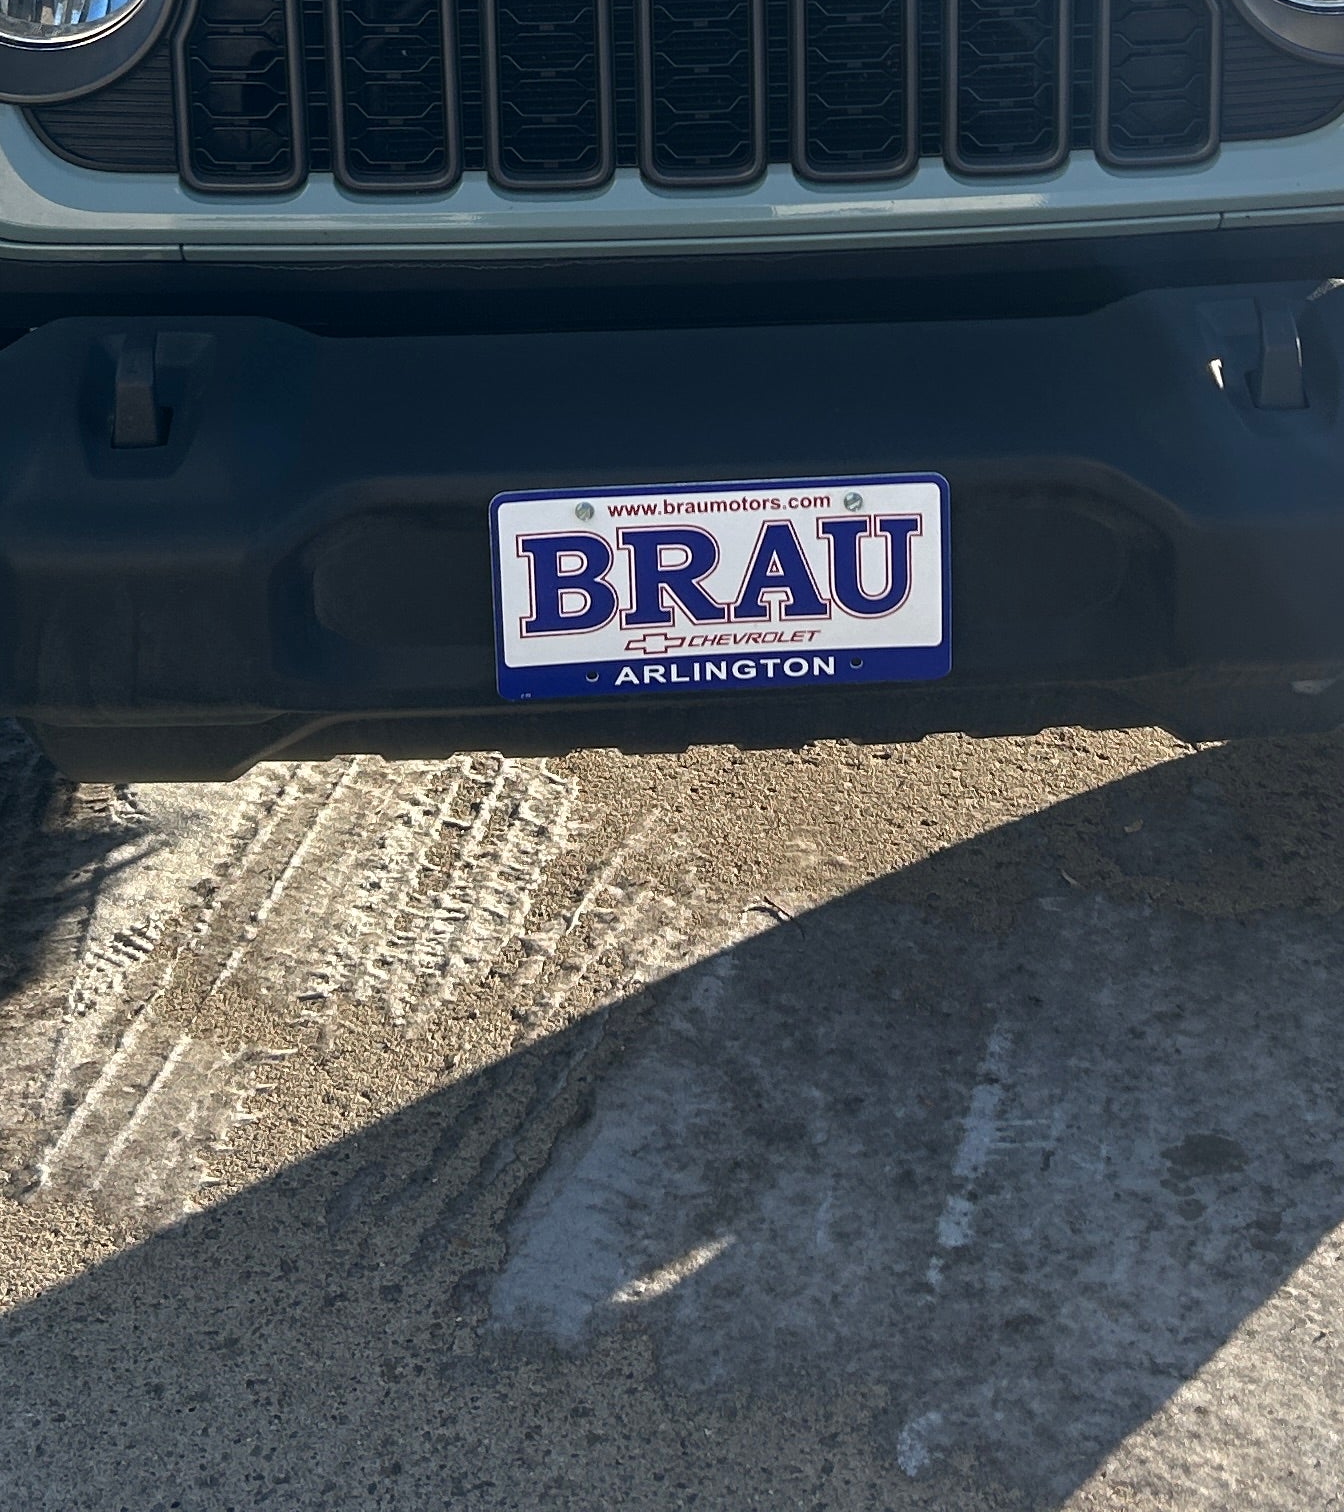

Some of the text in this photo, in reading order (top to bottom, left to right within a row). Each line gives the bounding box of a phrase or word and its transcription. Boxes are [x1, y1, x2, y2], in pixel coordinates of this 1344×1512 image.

[607, 492, 831, 517] www.braumotors.com
[516, 513, 923, 639] BRAU
[686, 629, 821, 649] CHEVROLET
[614, 656, 836, 686] ARLINGTON
